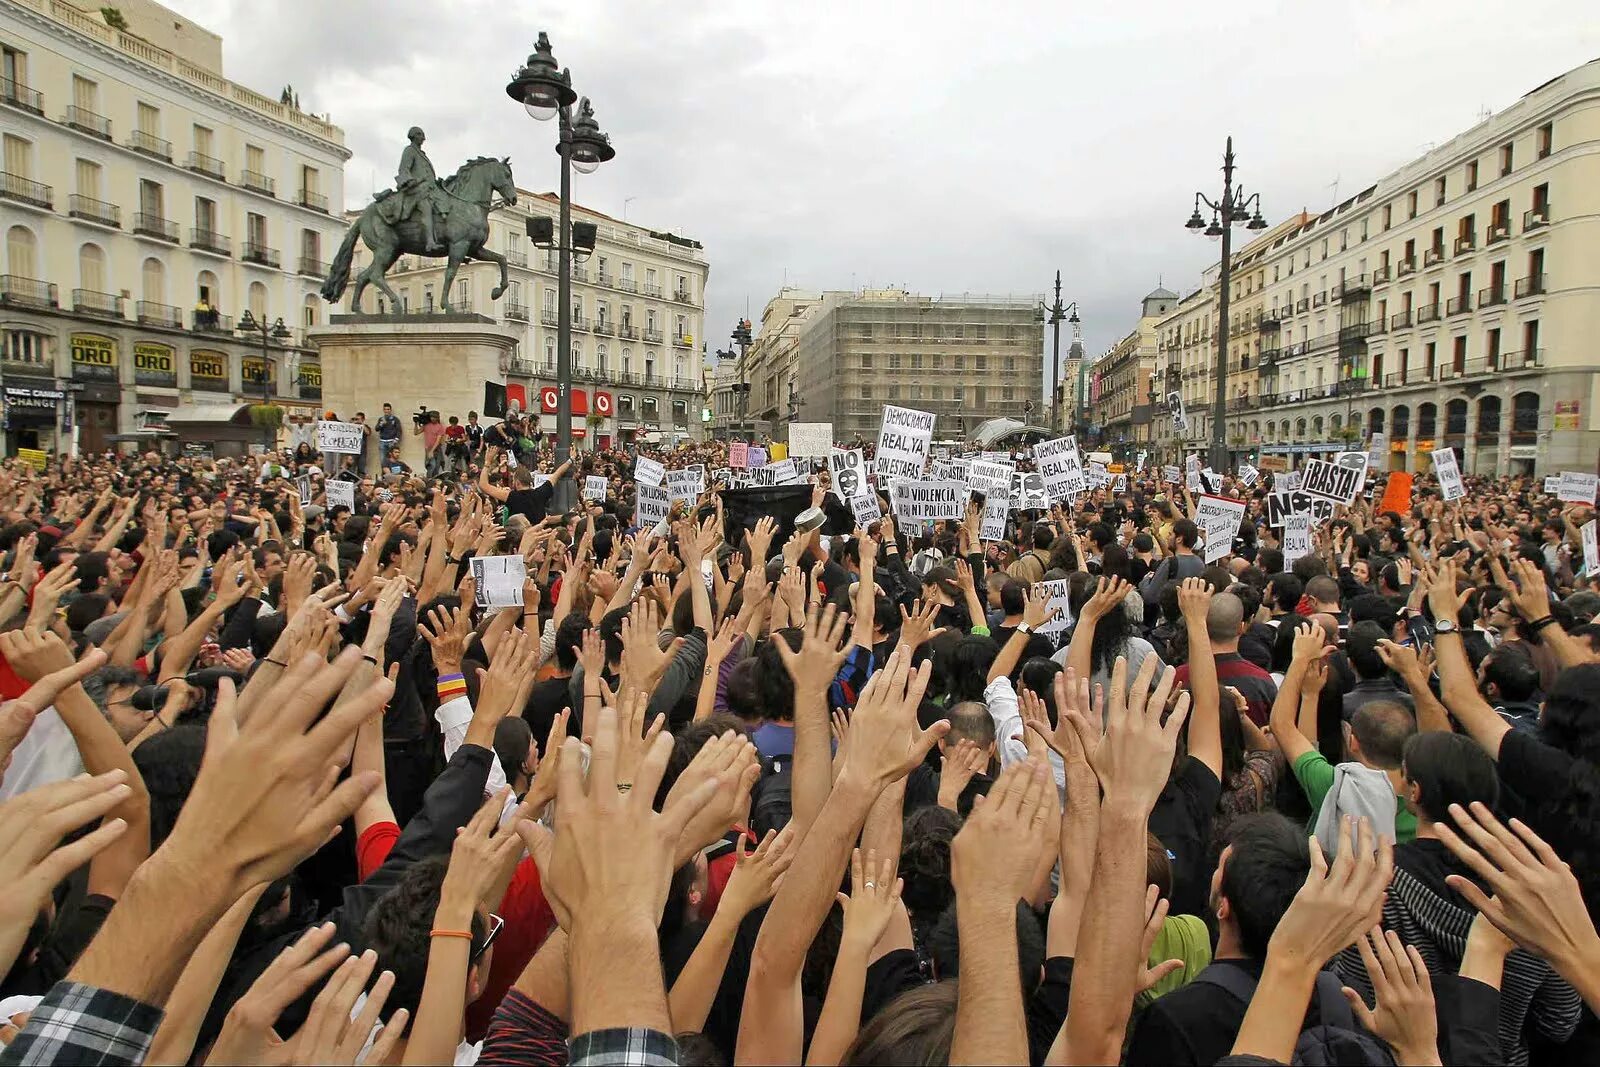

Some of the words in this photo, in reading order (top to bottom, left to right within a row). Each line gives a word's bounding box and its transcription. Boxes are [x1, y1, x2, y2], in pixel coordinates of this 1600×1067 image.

[72, 347, 111, 363] ORO
[135, 354, 170, 370] ORO
[191, 362, 222, 376] ORO
[886, 409, 932, 432] DEMOCRACIA
[882, 432, 909, 454] REAL,
[911, 438, 925, 456] YA,
[1037, 438, 1074, 458] DEMOCRACIA
[833, 451, 858, 472] NO
[878, 457, 889, 474] SIN
[1042, 462, 1065, 478] REAL,
[1064, 458, 1080, 472] YA,
[973, 464, 1004, 480] VIOLENCIA
[1302, 460, 1360, 500] ¡BASTA!
[911, 486, 959, 504] VIOLENCIA,
[1047, 482, 1058, 498] SIN
[640, 502, 648, 514] NI
[912, 502, 921, 516] NI
[1024, 499, 1045, 508] CENSURA
